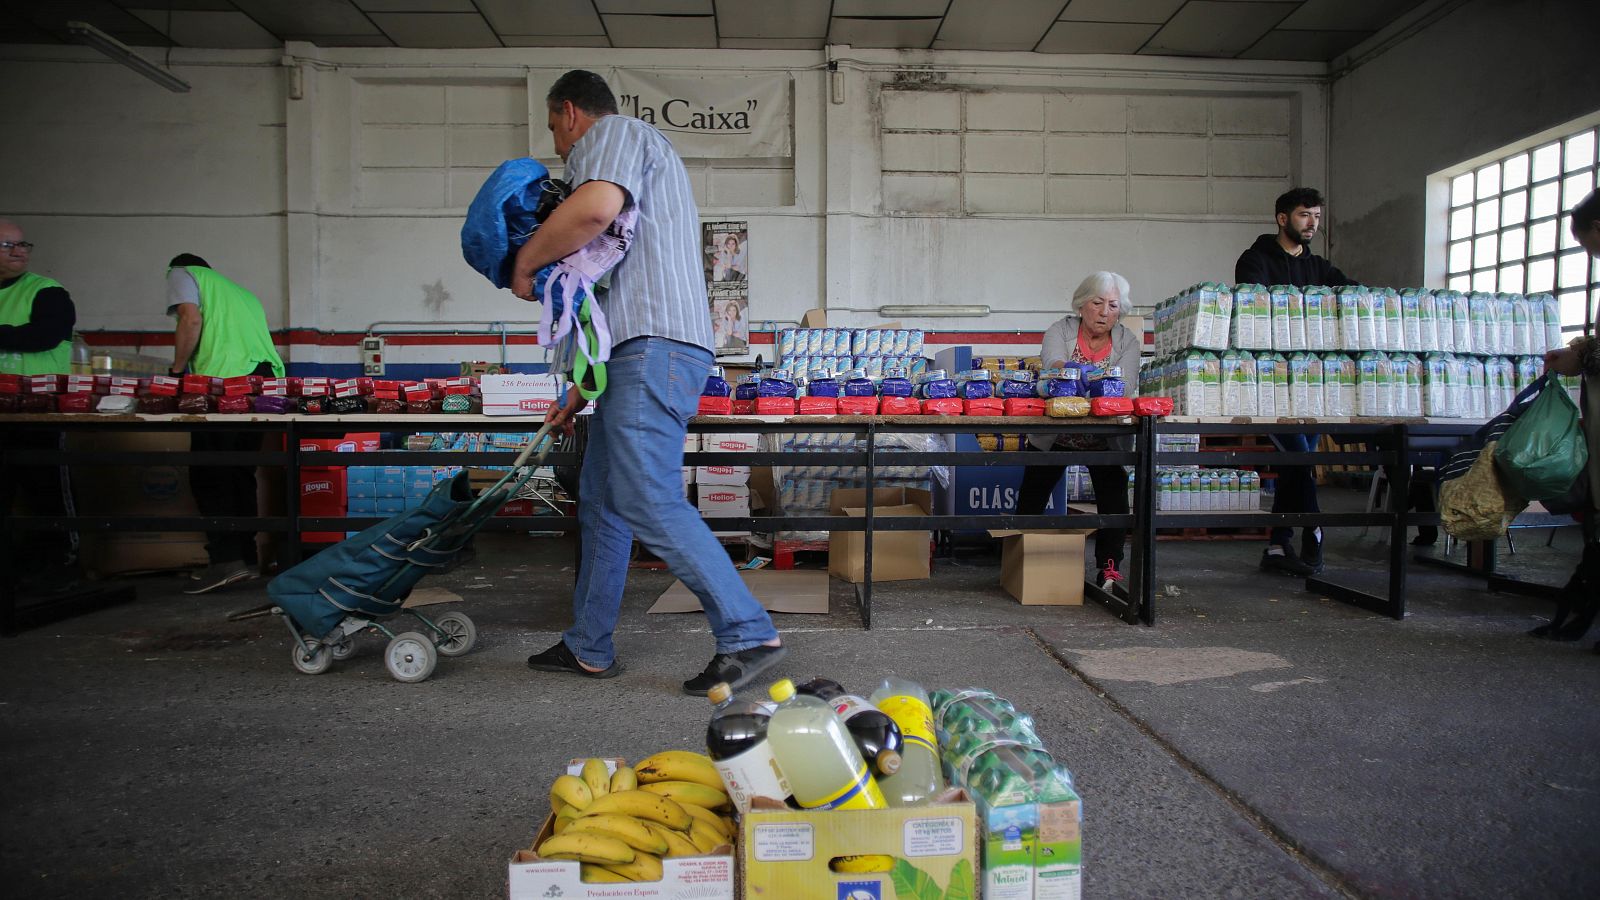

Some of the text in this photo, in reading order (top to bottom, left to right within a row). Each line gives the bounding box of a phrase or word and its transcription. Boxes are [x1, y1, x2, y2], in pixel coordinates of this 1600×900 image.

[661, 98, 758, 130] Caixa"
[522, 401, 551, 410] Helio
[721, 442, 745, 450] Helios
[305, 482, 329, 492] Royal
[970, 484, 1054, 509] CLÁSA
